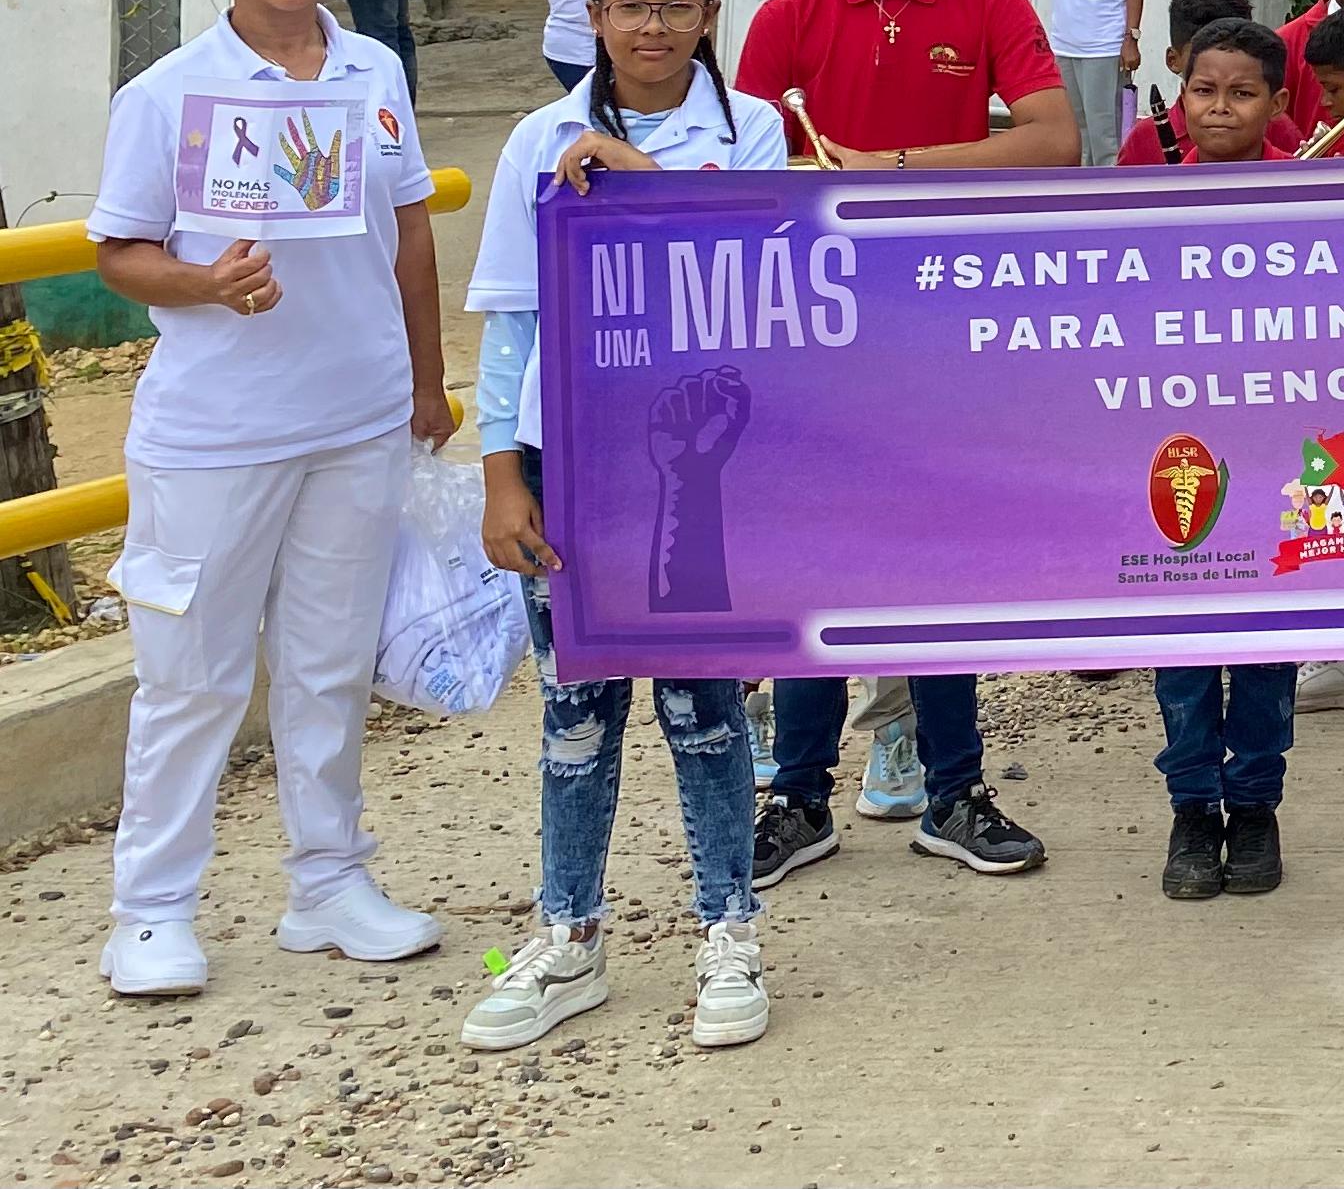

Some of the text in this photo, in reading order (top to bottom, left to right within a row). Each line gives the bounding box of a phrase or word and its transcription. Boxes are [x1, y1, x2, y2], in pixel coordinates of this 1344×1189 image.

[211, 178, 272, 192] NO MÁS
[210, 189, 269, 200] VIOLENCIA
[210, 197, 279, 210] DE GENERO
[916, 247, 1151, 291] #SANTA
[1180, 237, 1339, 281] ROSA
[591, 242, 645, 318] NI
[668, 220, 858, 352] MÁS
[969, 313, 1126, 353] PARA
[594, 328, 653, 369] UNA
[1121, 550, 1256, 568] ESE Hospital Local
[1299, 547, 1337, 560] MEJOR
[1117, 567, 1260, 585] Santa Rosa de Lima
